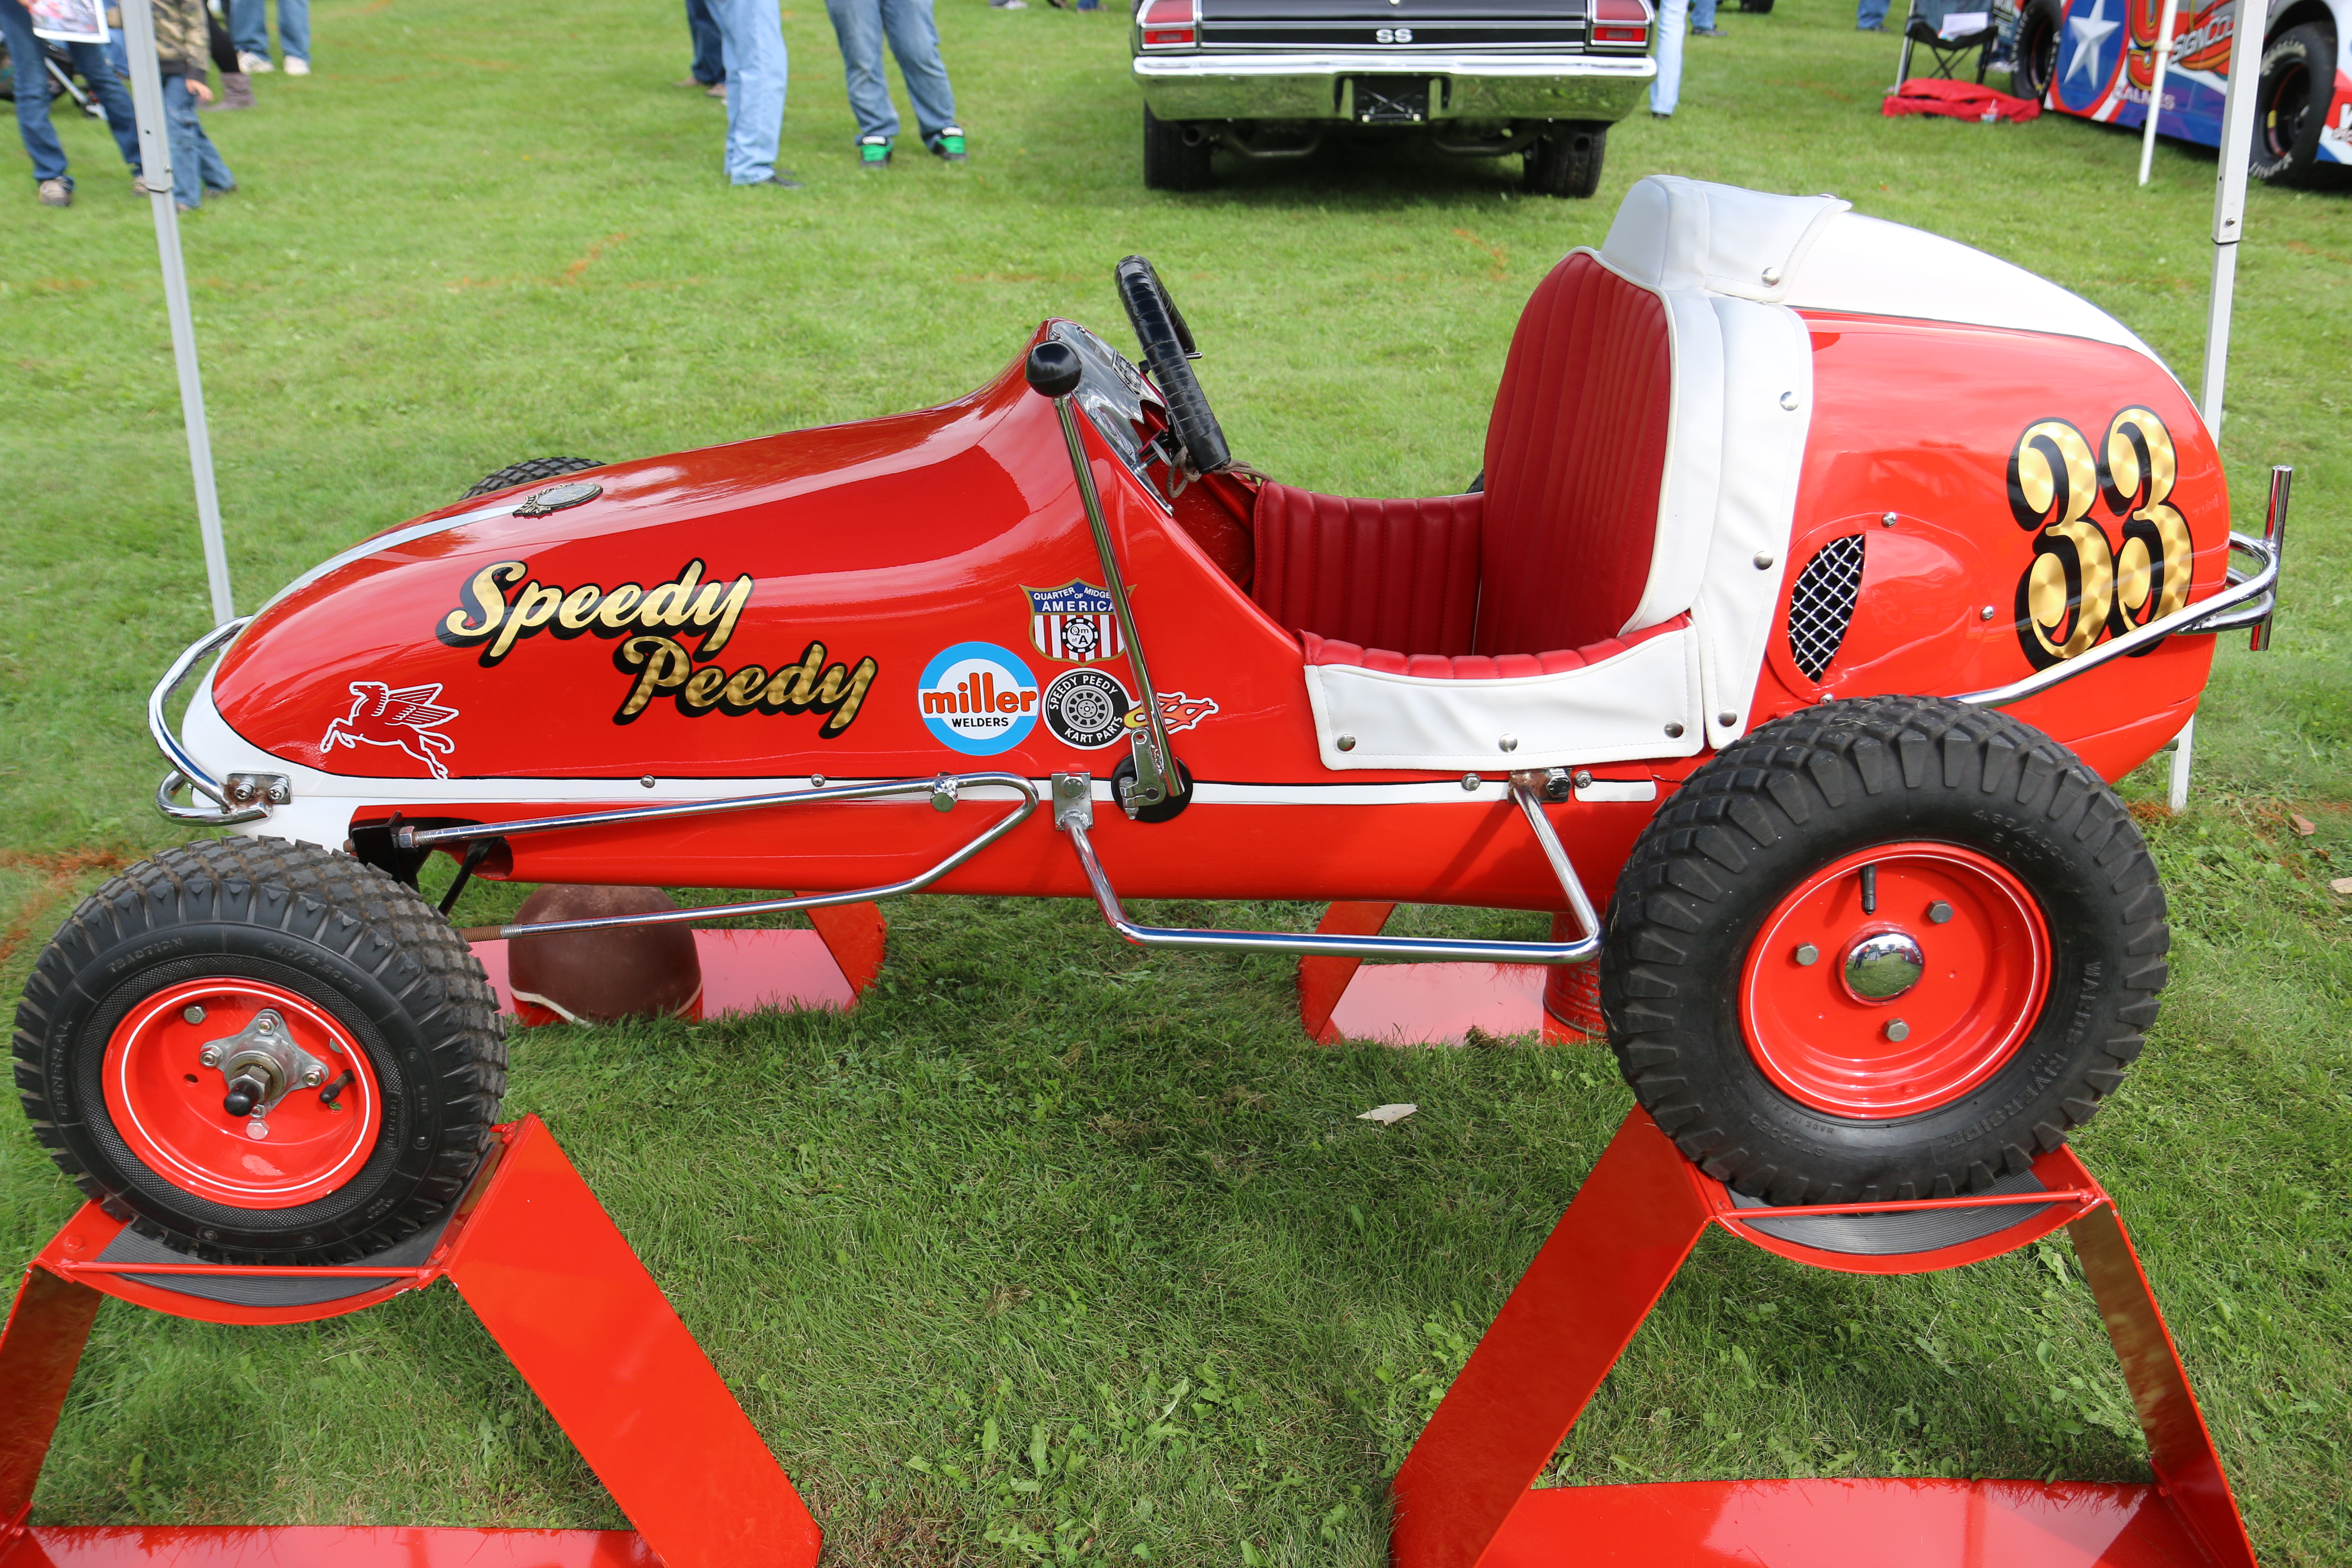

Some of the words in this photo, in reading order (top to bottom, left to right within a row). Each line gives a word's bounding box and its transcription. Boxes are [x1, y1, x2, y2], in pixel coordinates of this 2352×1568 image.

[1376, 29, 1413, 43] SS
[2007, 404, 2194, 671] 33
[1033, 587, 1075, 600] QUARTER
[1084, 587, 1110, 599] MIDGE
[435, 557, 754, 668] Speedy
[1078, 635, 1089, 644] A
[612, 636, 879, 739] Peedy
[923, 672, 1037, 714] miller
[1050, 676, 1078, 710] SPEEDY
[1083, 675, 1118, 695] PEEDY
[951, 717, 1009, 727] WELDERS
[1064, 727, 1092, 743] KART
[1096, 716, 1123, 742] PARTS
[2012, 841, 2042, 861] PLY
[107, 937, 184, 974] TRACTION
[2064, 962, 2101, 1044] WARDS
[1945, 1053, 2068, 1148] RIVERSIDE
[1791, 1115, 1801, 1124] IN
[1805, 1121, 1834, 1134] MADE
